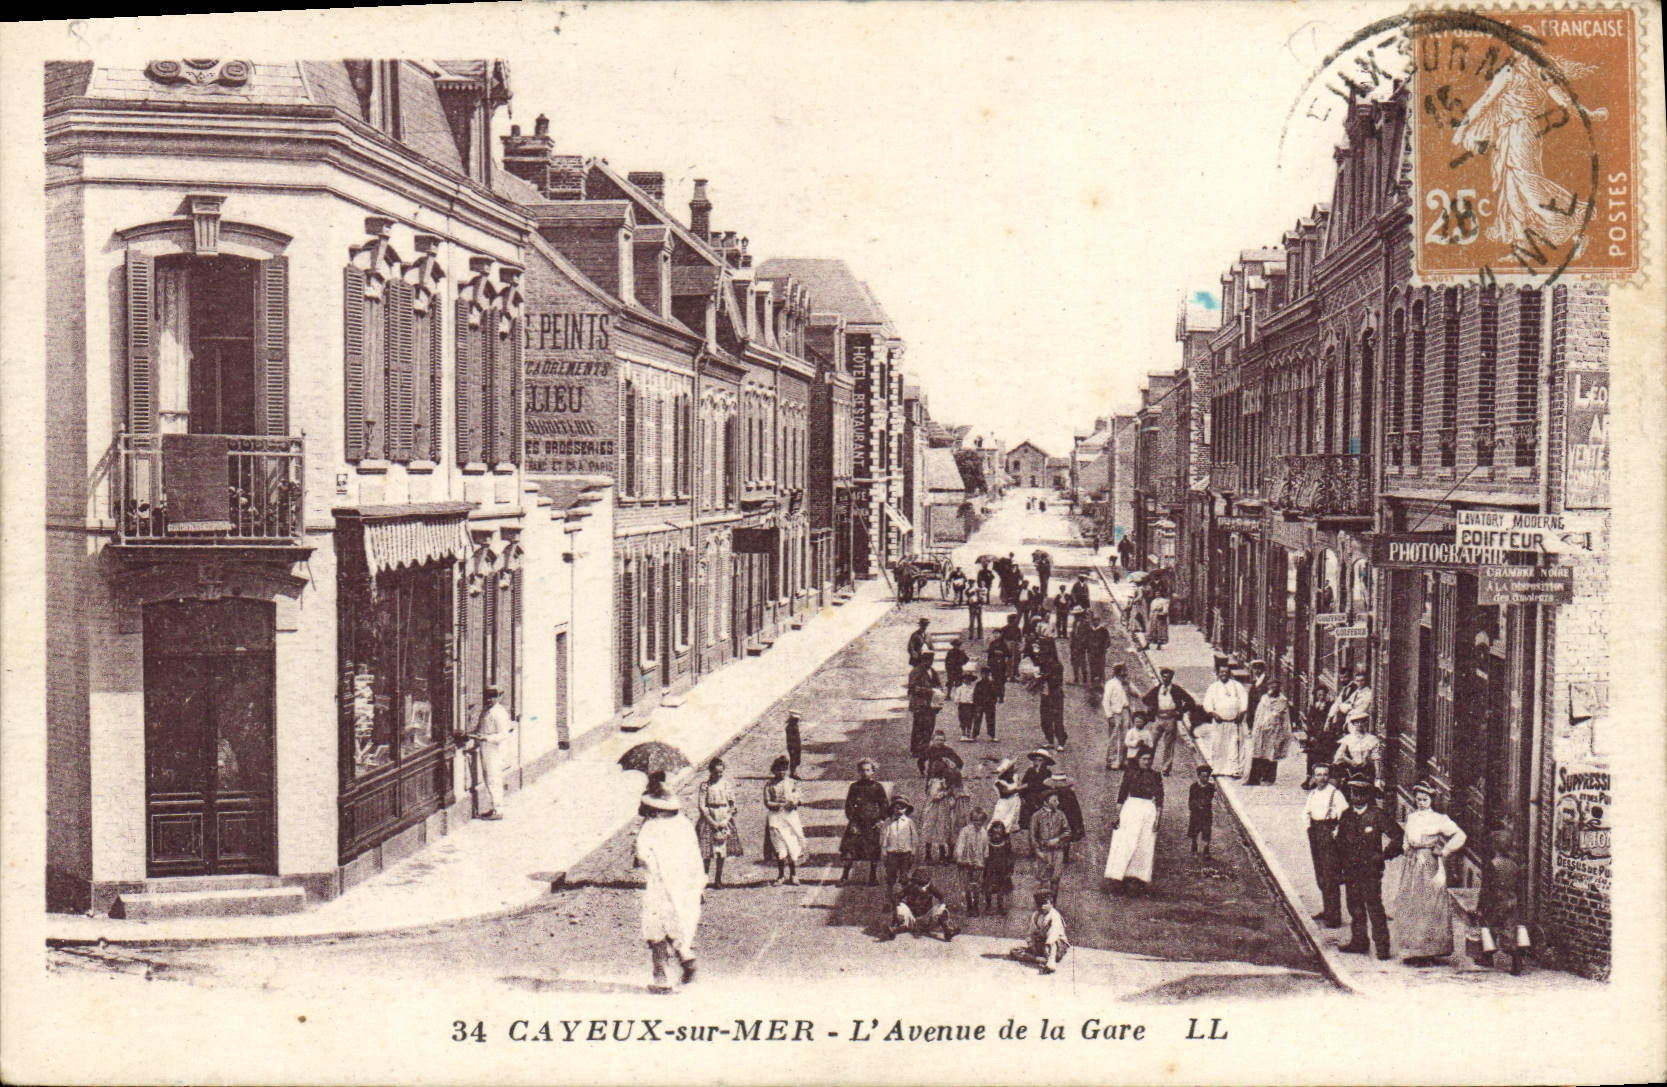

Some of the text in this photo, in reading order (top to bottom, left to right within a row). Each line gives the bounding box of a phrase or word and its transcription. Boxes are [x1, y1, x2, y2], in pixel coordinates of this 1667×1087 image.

[1541, 19, 1624, 38] FRANÇAISE
[1424, 188, 1480, 245] 25
[1608, 171, 1628, 258] POSTES
[540, 313, 610, 350] PEINTS
[852, 393, 865, 467] RESTAURANT
[1458, 511, 1504, 527] LAVATORY
[1389, 542, 1507, 565] PHOTOGRAPHIE
[1462, 530, 1547, 552] COIFFEUR
